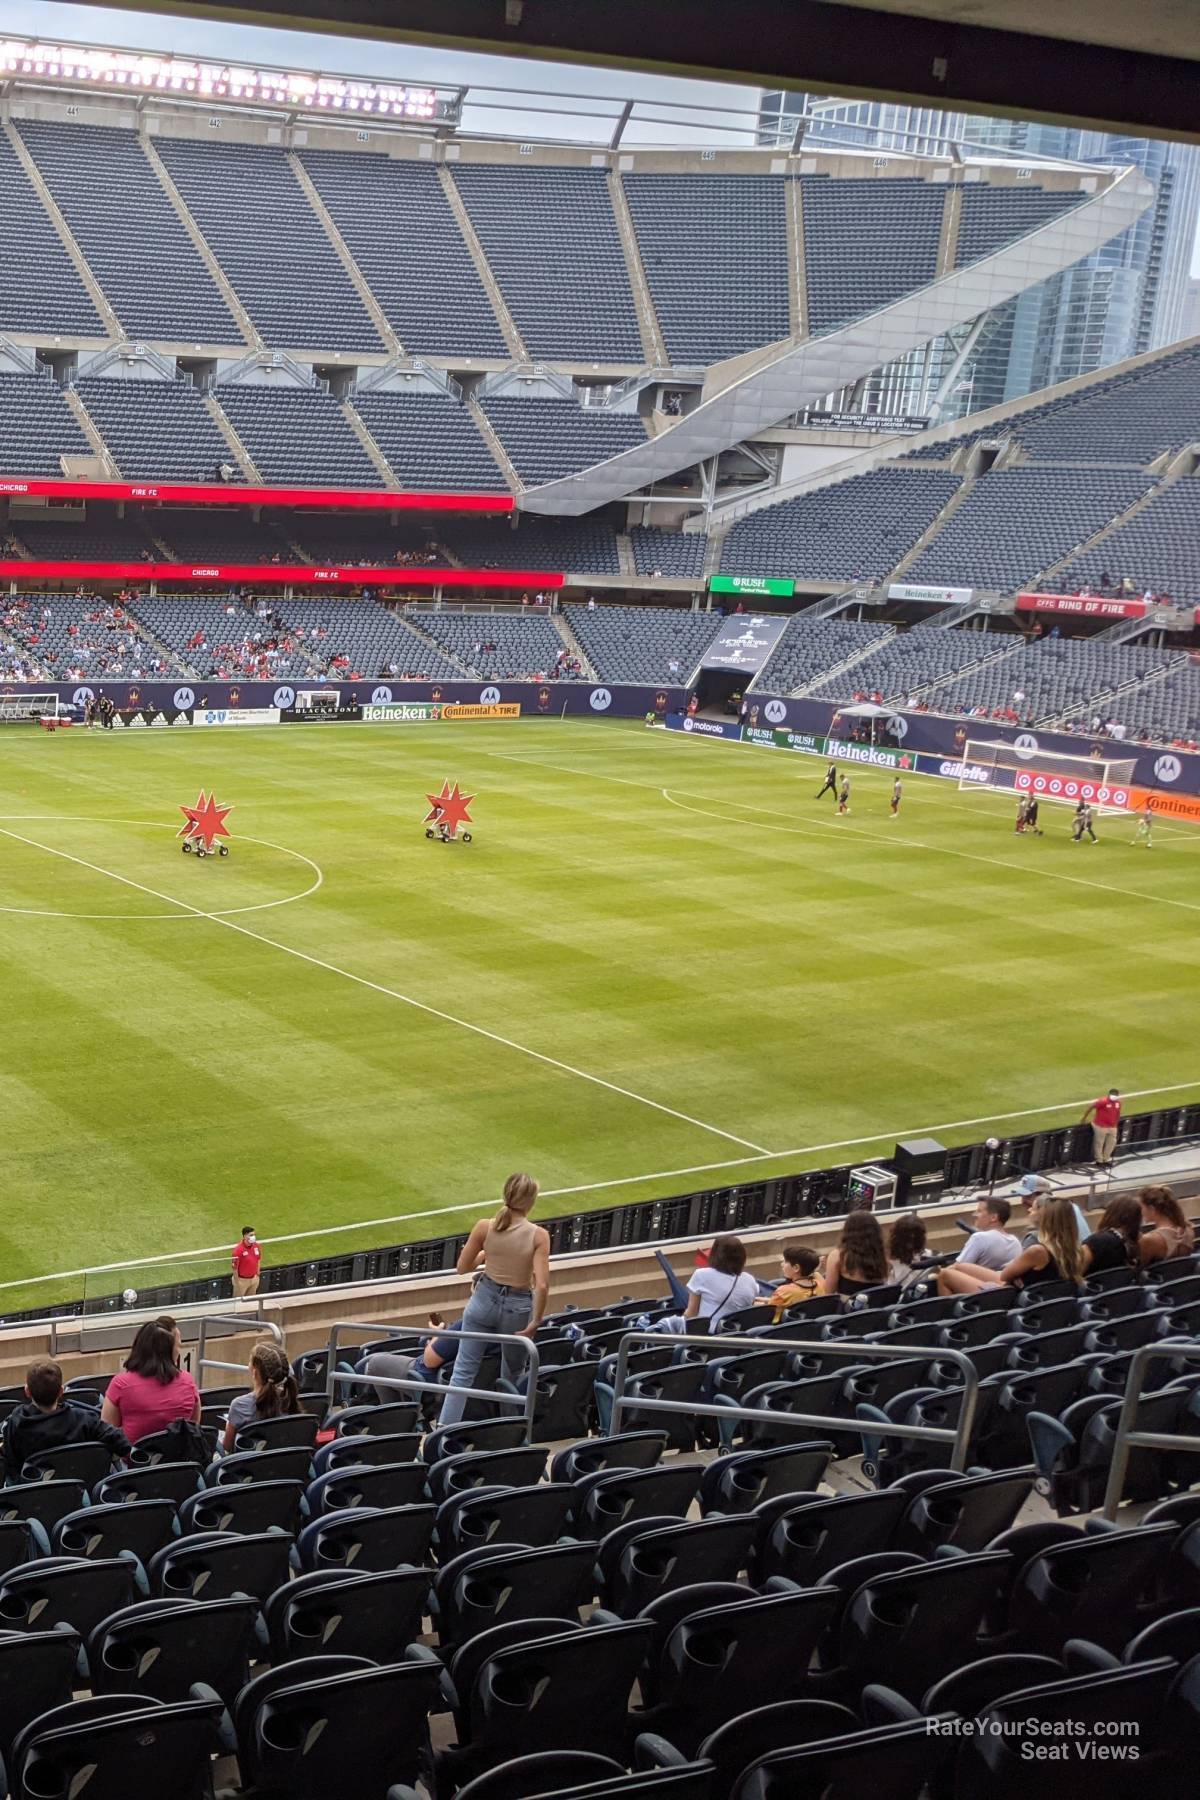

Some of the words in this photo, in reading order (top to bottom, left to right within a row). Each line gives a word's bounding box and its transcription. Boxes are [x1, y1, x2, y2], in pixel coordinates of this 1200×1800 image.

[209, 117, 221, 127] 442
[131, 488, 146, 496] FIRE
[741, 578, 765, 588] RUSH
[1057, 601, 1082, 610] RING
[1085, 603, 1098, 612] OF
[1102, 604, 1125, 614] FIRE
[362, 705, 426, 720] Heineken
[443, 705, 490, 718] Continental
[499, 706, 518, 714] TIRE
[693, 722, 723, 733] motorola
[753, 728, 773, 739] RUSH
[793, 734, 815, 746] RUSH
[827, 740, 896, 766] Heineken
[939, 761, 988, 781] Gillette
